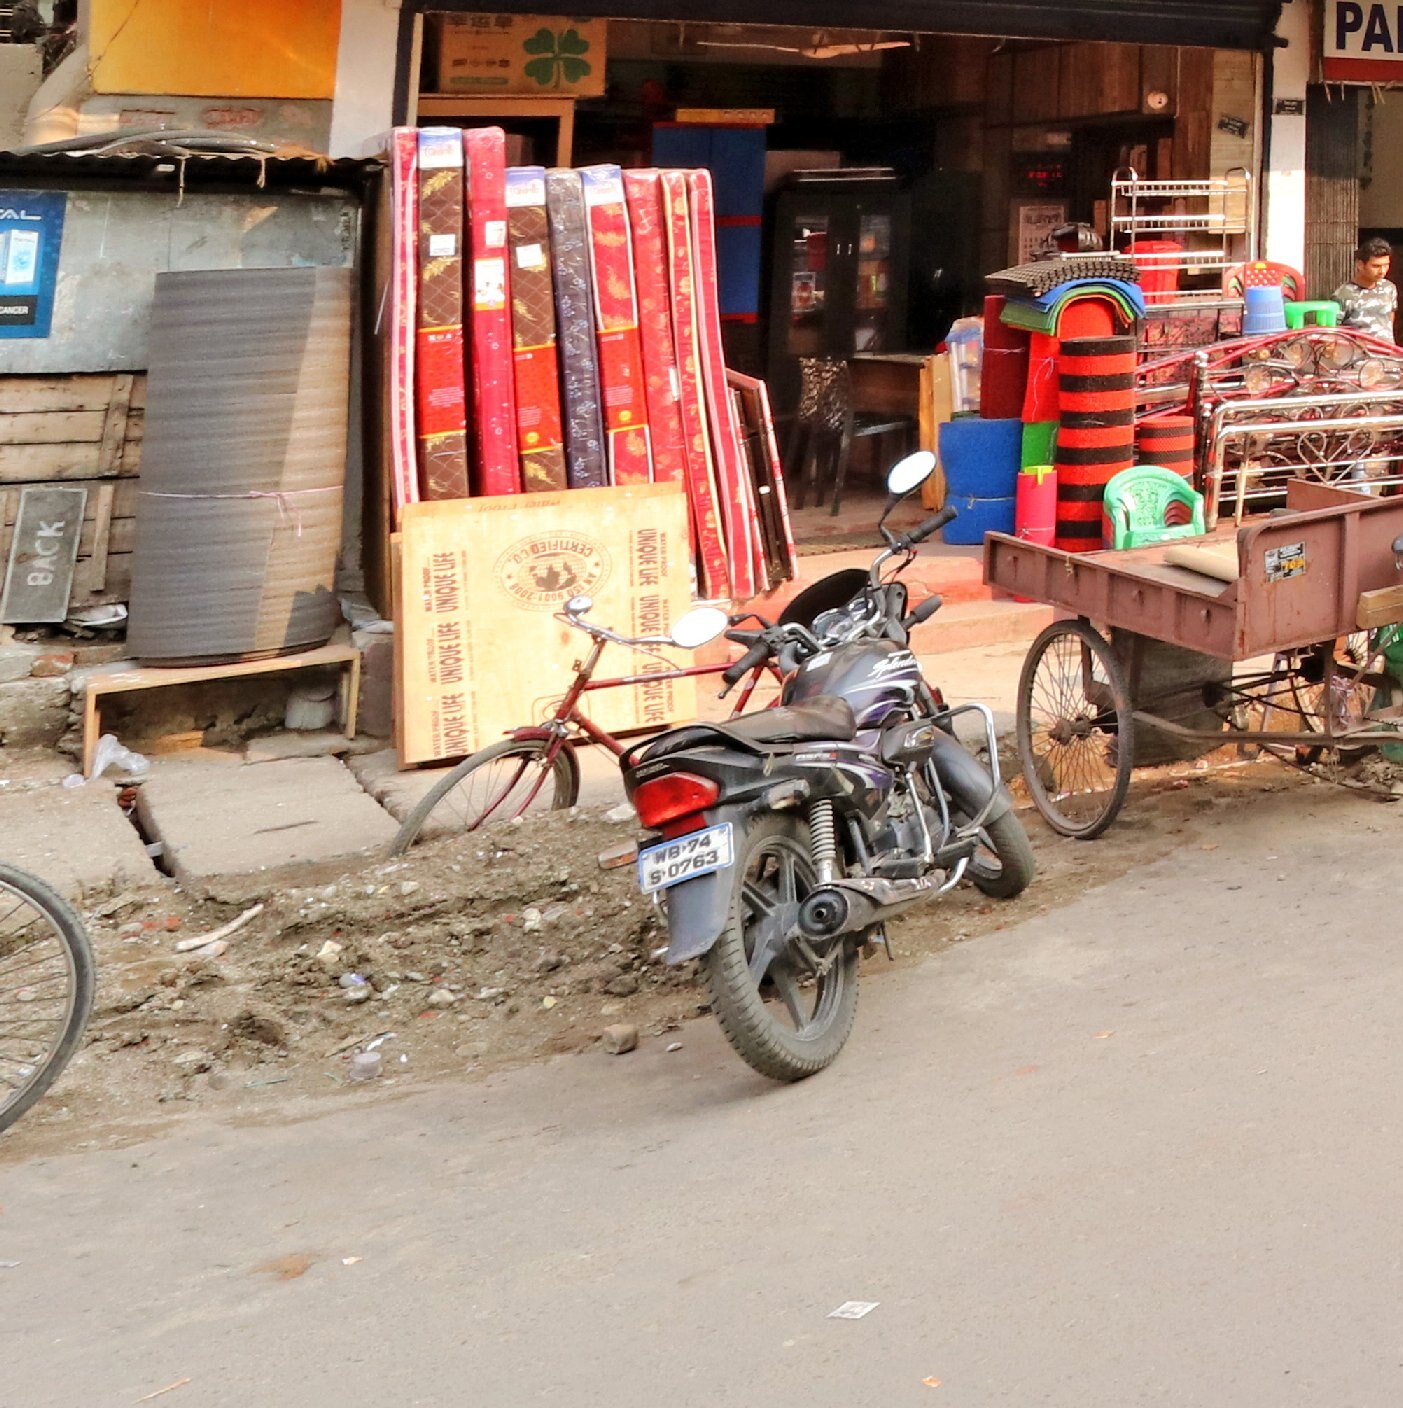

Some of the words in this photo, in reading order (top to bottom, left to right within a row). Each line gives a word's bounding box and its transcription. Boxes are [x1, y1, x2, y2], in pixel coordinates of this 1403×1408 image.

[26, 520, 66, 586] BACK
[433, 551, 456, 570] LIFE
[529, 539, 594, 558] CERTIFIED
[637, 528, 658, 565] UNIQUE
[638, 567, 659, 586] LIFE
[436, 571, 459, 613] UNIQUE
[638, 595, 660, 633] UNIQUE
[437, 621, 459, 642] LIFE
[438, 643, 463, 684] UNIQUE
[442, 693, 465, 713] LIFE
[644, 704, 665, 723] LIFE
[444, 715, 468, 756] UNIQUE
